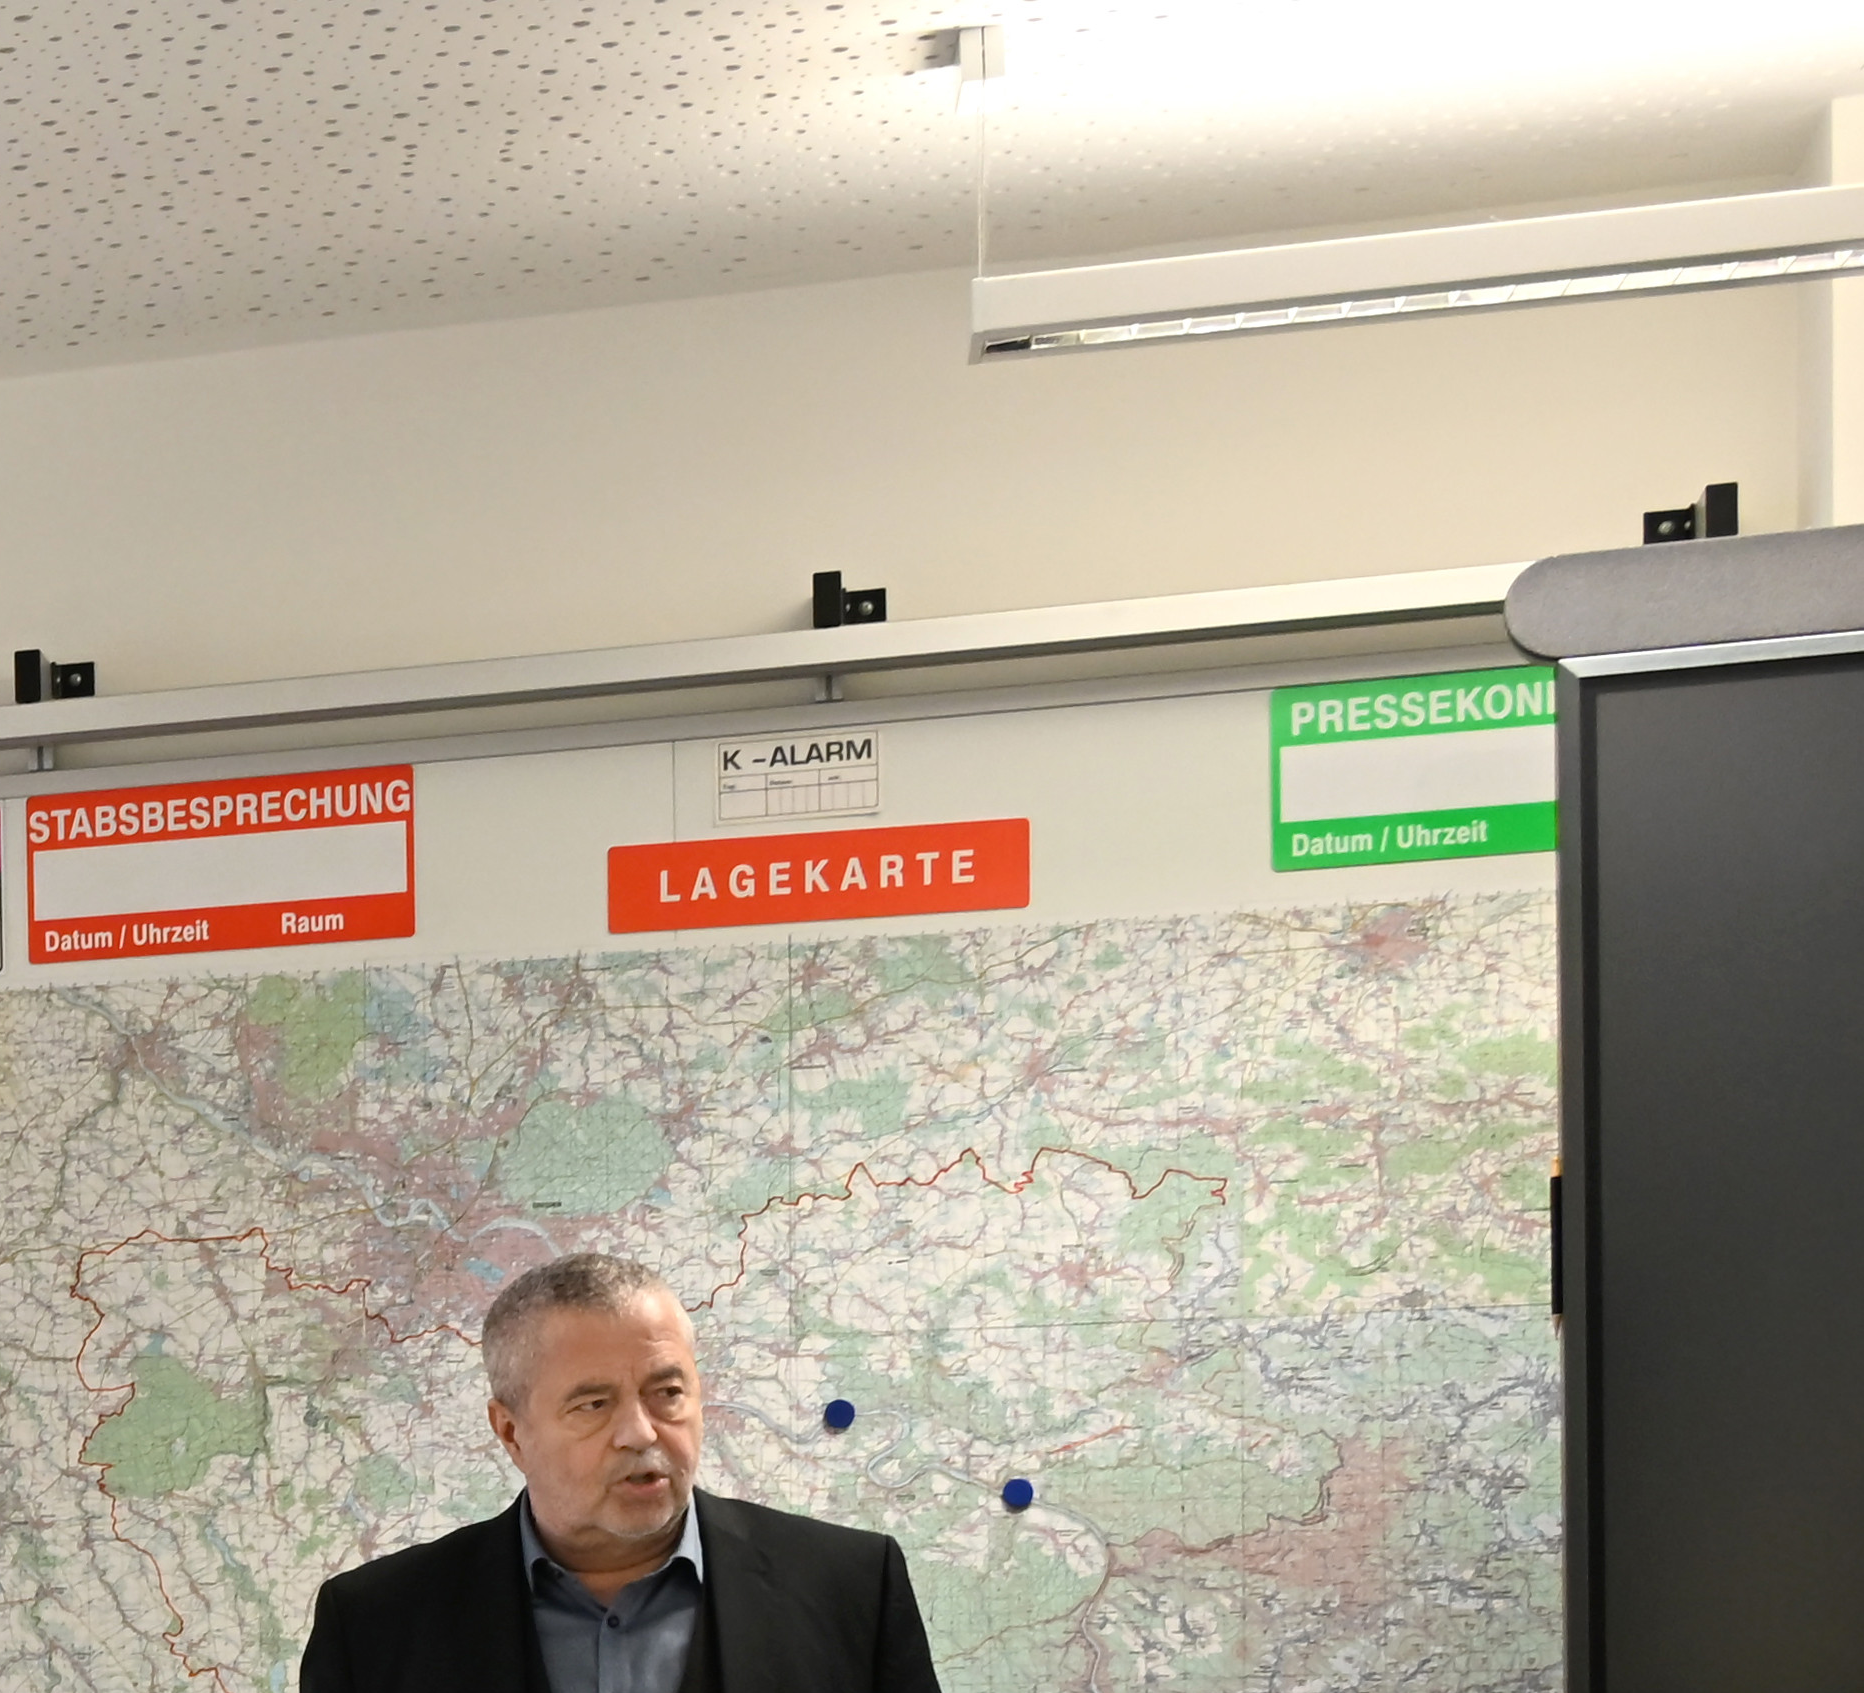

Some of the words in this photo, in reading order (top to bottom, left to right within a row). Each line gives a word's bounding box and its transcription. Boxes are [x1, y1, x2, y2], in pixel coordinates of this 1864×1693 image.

[27, 779, 411, 845] STABSBESPRECHUNG
[1291, 832, 1373, 857] Datum
[1396, 820, 1489, 848] Uhrzeit
[658, 847, 977, 905] LAGEKARTE
[43, 924, 113, 953] Datum
[132, 916, 211, 947] Uhrzeit
[280, 907, 345, 936] Raum
